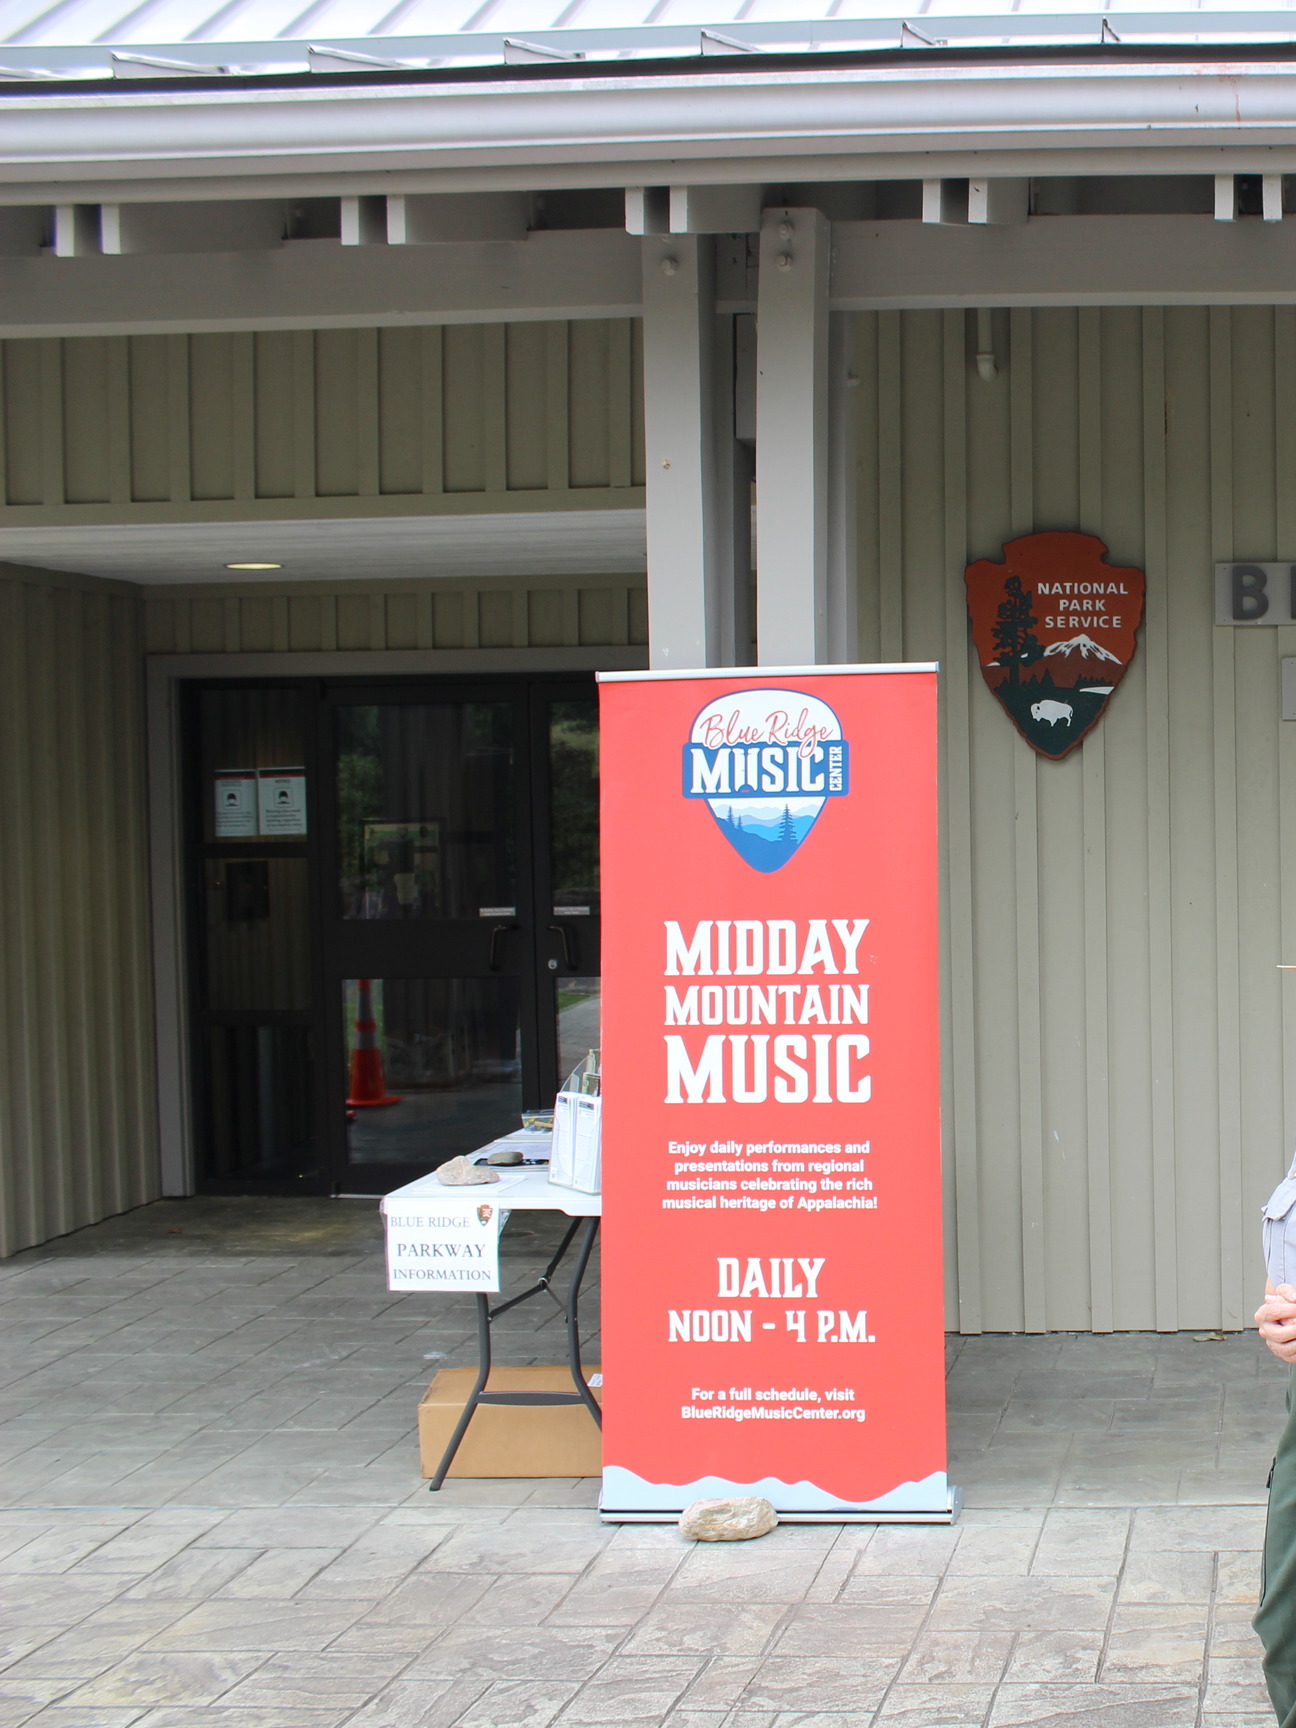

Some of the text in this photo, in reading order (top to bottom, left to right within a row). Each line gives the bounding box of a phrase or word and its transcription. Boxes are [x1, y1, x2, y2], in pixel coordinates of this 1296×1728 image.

[1037, 582, 1129, 595] NATIONAL
[1059, 599, 1106, 611] PARK
[1044, 616, 1122, 628] SERVICE
[700, 707, 834, 758] Blue Ridge
[690, 747, 825, 793] MUSIC
[829, 746, 843, 791] CENTER
[663, 918, 870, 976] MIDDAY
[664, 983, 870, 1026] MOUNTAIN
[663, 1033, 872, 1104] MUSIC
[668, 1140, 870, 1157] Enjoy daily performances and
[674, 1159, 864, 1175] presentations from regional
[666, 1177, 873, 1193] musicians celebrating the rich
[662, 1196, 878, 1211] musical heritage of Appalachia!
[390, 1216, 471, 1228] BLUE RIDGE
[397, 1243, 486, 1257] PARKWAY
[393, 1268, 491, 1280] INFORMATION
[717, 1257, 826, 1298] DAILY
[668, 1309, 752, 1342] NOON
[785, 1310, 806, 1342] 4
[816, 1310, 876, 1342] P.M.
[691, 1387, 855, 1403] For a full schedule, visit
[681, 1406, 865, 1422] BlueRidgeMusicCenter.org
